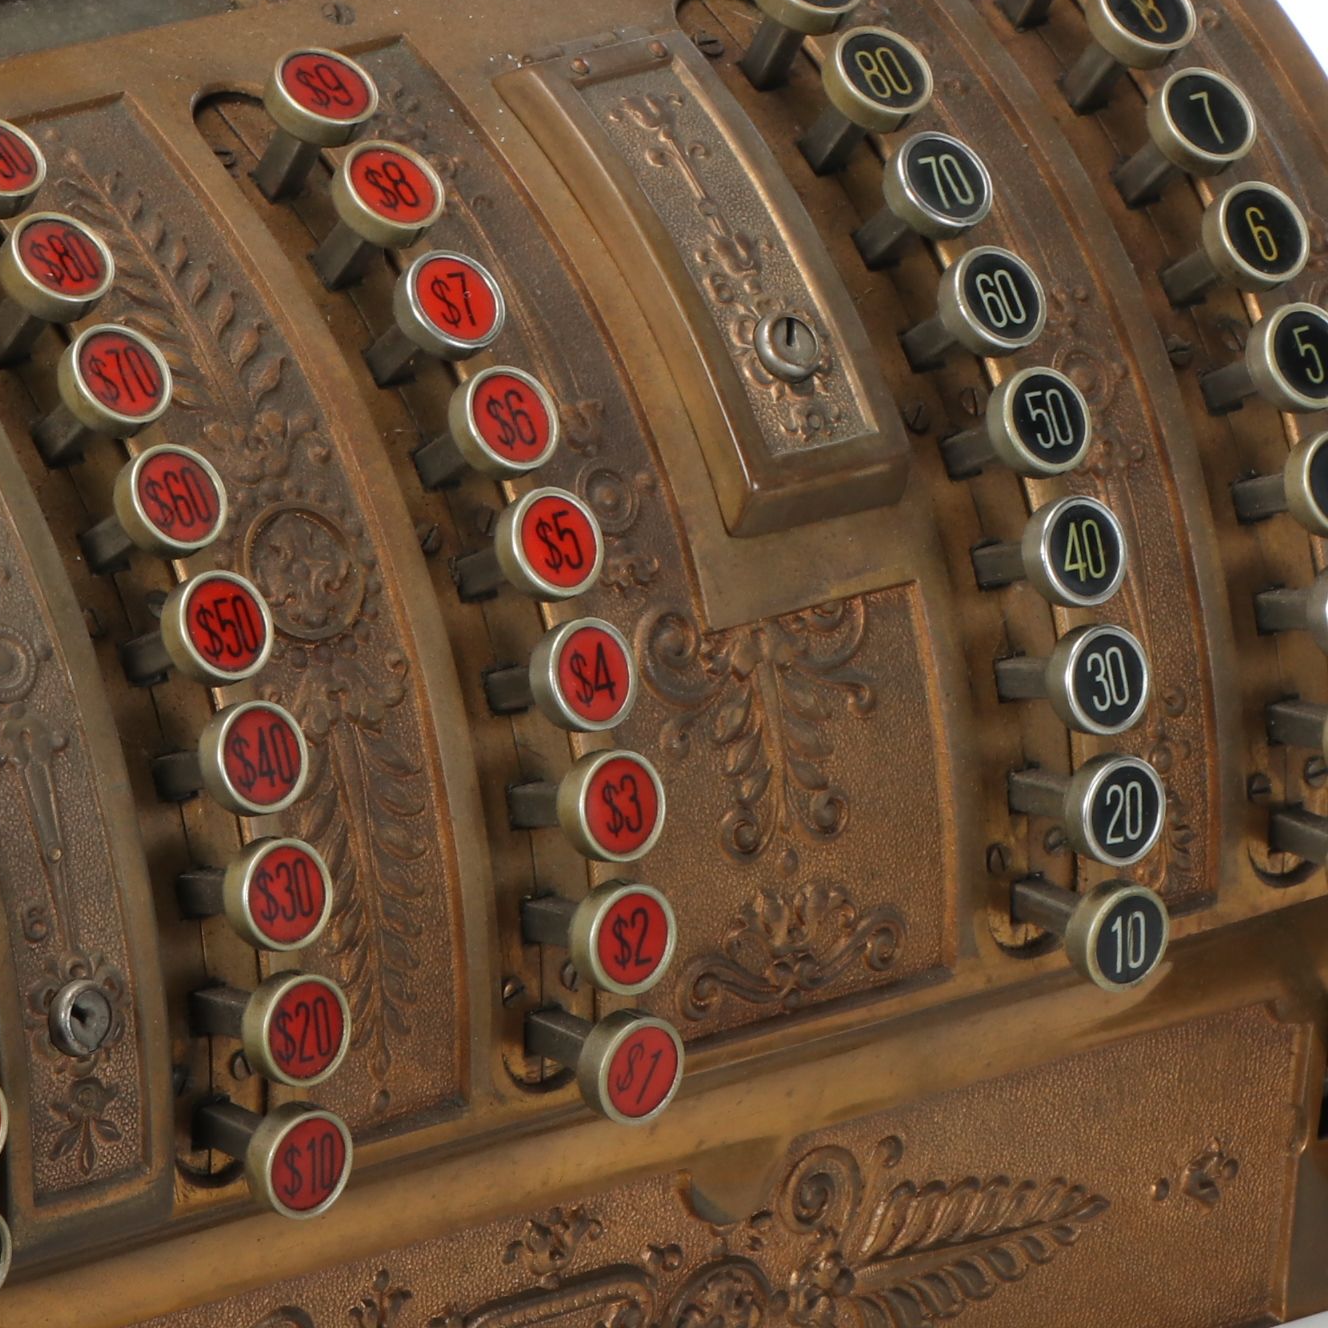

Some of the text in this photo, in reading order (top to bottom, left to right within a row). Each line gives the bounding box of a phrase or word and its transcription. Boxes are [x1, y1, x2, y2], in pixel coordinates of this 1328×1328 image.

[296, 63, 355, 109] $9
[854, 47, 913, 100] 80
[1189, 90, 1225, 145] 7
[364, 160, 420, 212] $8
[918, 153, 975, 210] 70
[29, 228, 100, 285] $80
[1245, 206, 1278, 262] 6
[430, 271, 478, 330] $7
[975, 268, 1027, 329] 60
[88, 345, 158, 406] $70
[1292, 324, 1324, 384] 5
[486, 389, 537, 450] $6
[1025, 387, 1074, 450] 50
[145, 465, 214, 529] $60
[536, 509, 584, 574] $5
[1063, 519, 1107, 583] 40
[195, 593, 260, 661] $50
[569, 641, 617, 709] $4
[1087, 645, 1130, 713] 30
[230, 722, 295, 793] $40
[601, 774, 643, 839] $3
[1105, 780, 1144, 846] 20
[254, 857, 315, 925] $30
[612, 906, 653, 969] $2
[1110, 909, 1146, 974] 10
[275, 995, 333, 1064] $20
[616, 1039, 663, 1105] $1
[283, 1131, 335, 1200] $10
